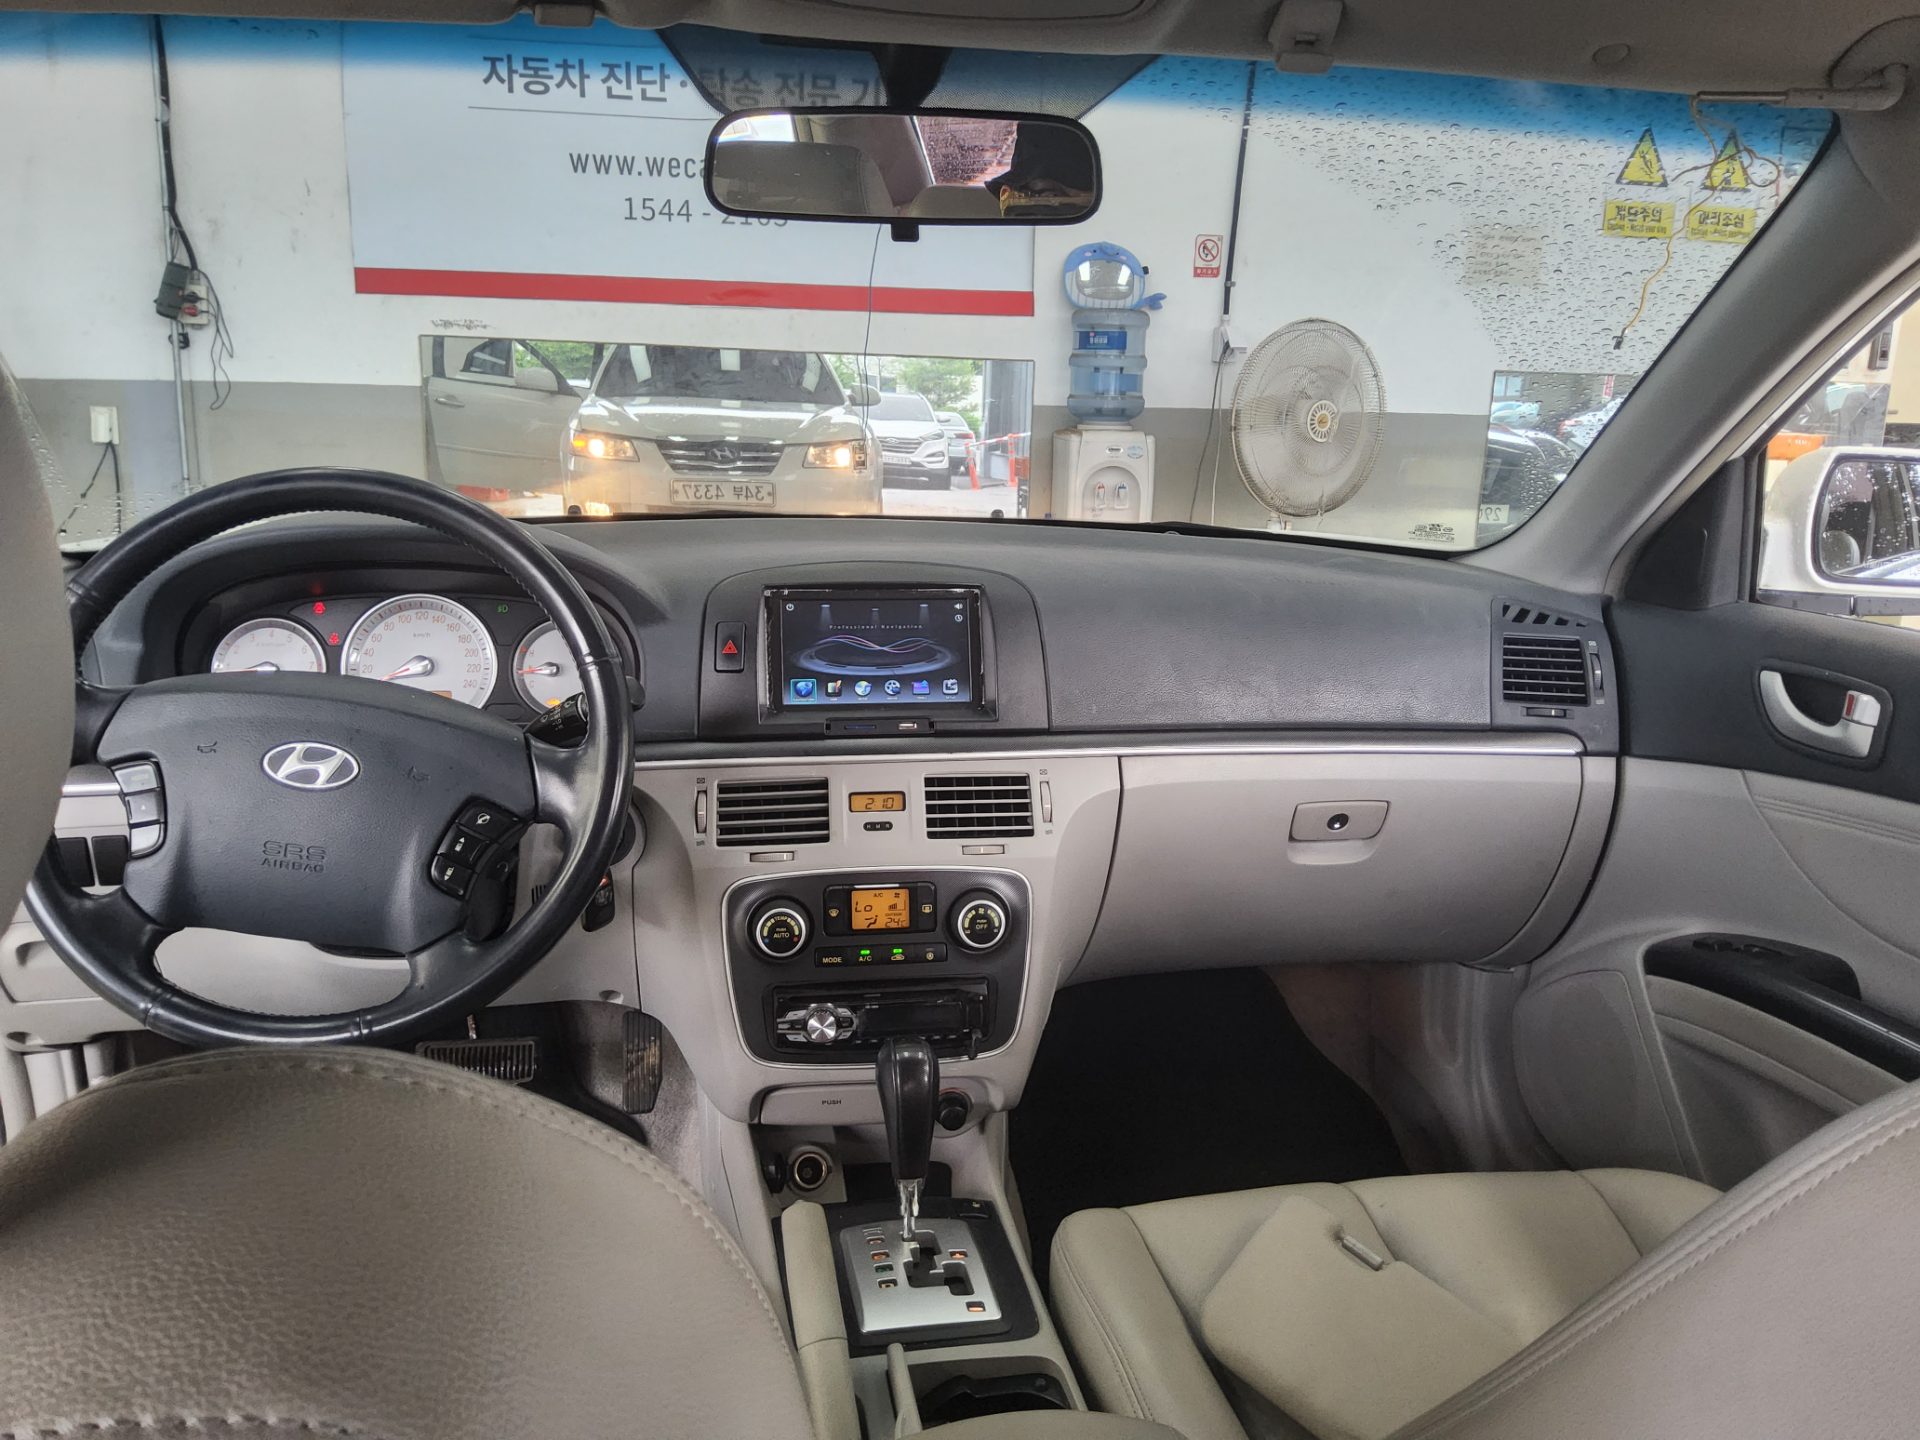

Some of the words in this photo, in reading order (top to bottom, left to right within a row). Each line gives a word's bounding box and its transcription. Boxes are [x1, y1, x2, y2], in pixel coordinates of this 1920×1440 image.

[482, 54, 590, 98] 자동차
[624, 197, 692, 223] 1544
[398, 615, 412, 624] 100
[415, 611, 429, 620] 120
[432, 615, 446, 624] 140
[383, 621, 394, 631] 80
[447, 623, 461, 632] 160
[371, 634, 383, 643] 60
[458, 634, 472, 643] 180
[363, 648, 374, 657] 40
[464, 648, 478, 657] 200
[361, 664, 373, 674] 20
[466, 663, 481, 673] 220
[463, 679, 477, 689] 240
[262, 840, 326, 861] SRS
[261, 858, 324, 873] AIRBAG
[822, 956, 842, 964] MODE
